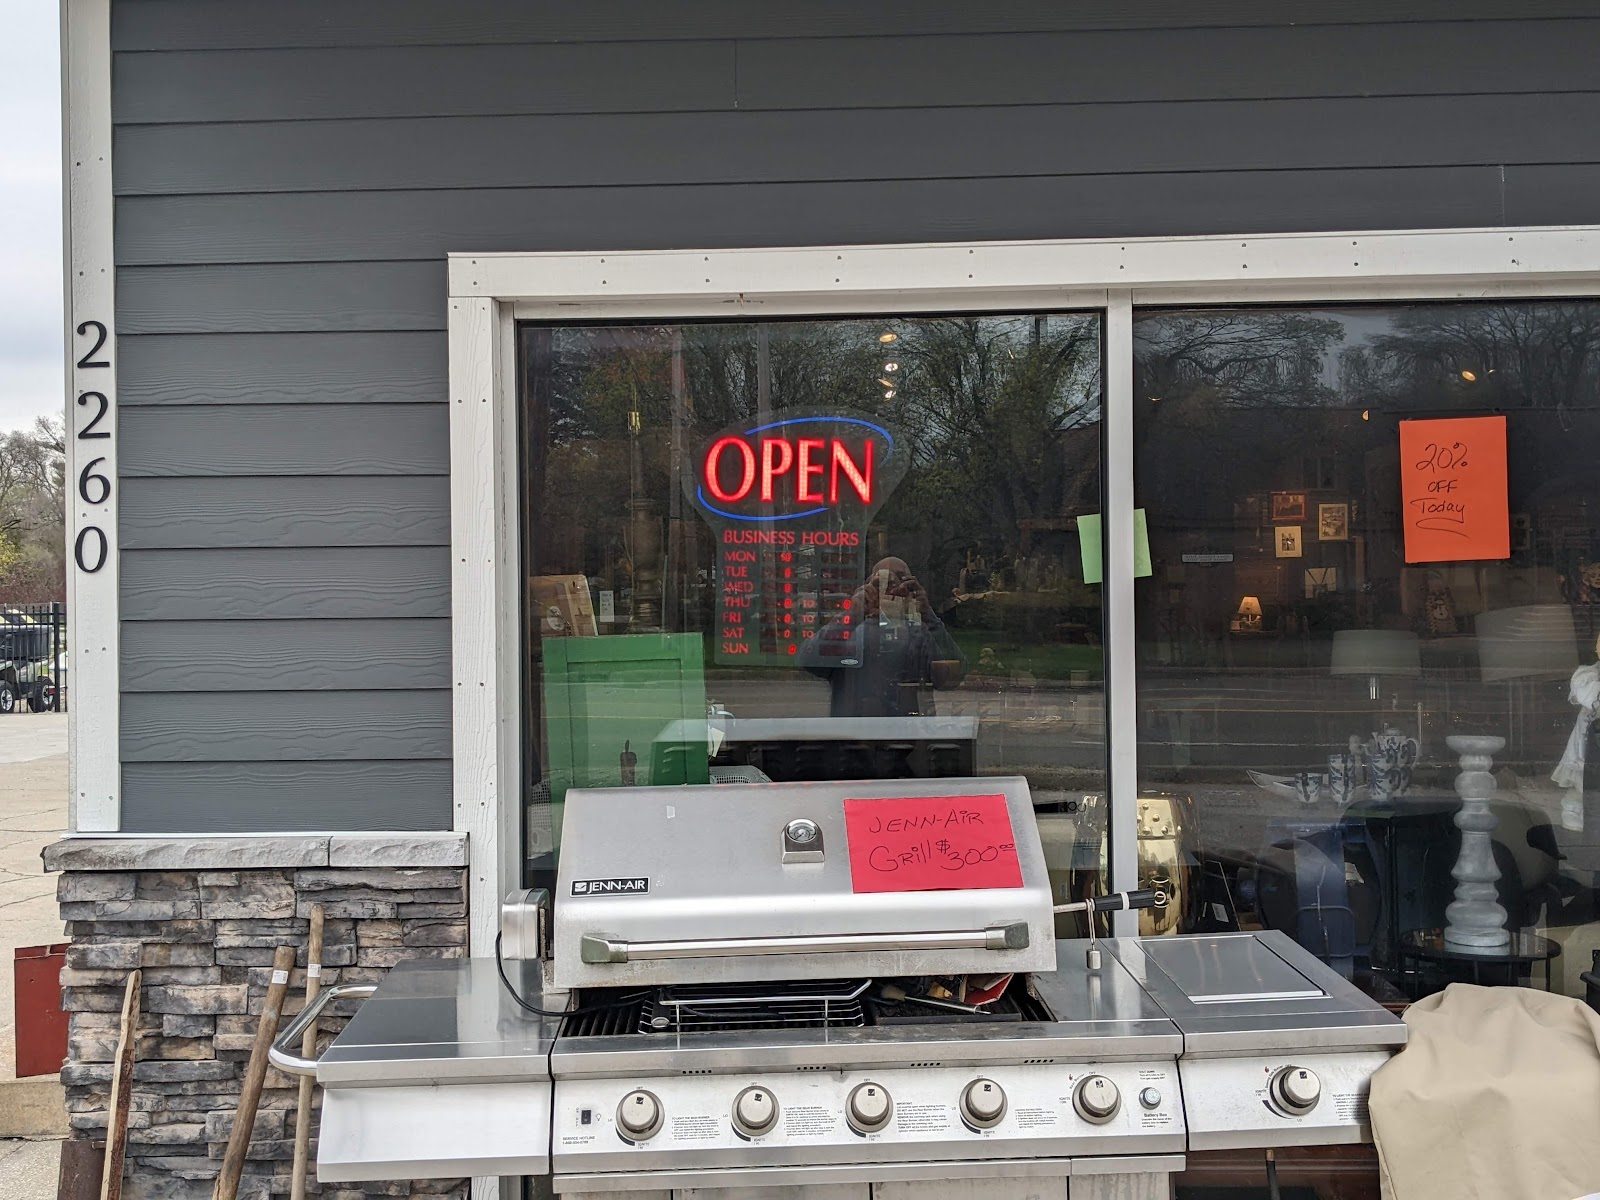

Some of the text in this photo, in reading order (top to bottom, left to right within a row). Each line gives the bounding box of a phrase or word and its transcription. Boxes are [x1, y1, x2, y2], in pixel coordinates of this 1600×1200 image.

[75, 320, 111, 574] 2260
[1415, 442, 1468, 474] 20%
[704, 436, 875, 504] OPEN
[1427, 479, 1458, 493] OFF
[1410, 497, 1465, 524] Today
[723, 530, 860, 546] BUSINESS HOURS
[724, 550, 756, 562] MON
[724, 566, 748, 578] TUE
[724, 581, 754, 593] WED
[724, 596, 752, 608] THU
[722, 611, 742, 623] FRI
[802, 614, 816, 624] TO
[722, 627, 745, 638] SAT
[802, 630, 815, 639] TO
[722, 642, 749, 654] SUN
[587, 880, 646, 894] JENN-AIR
